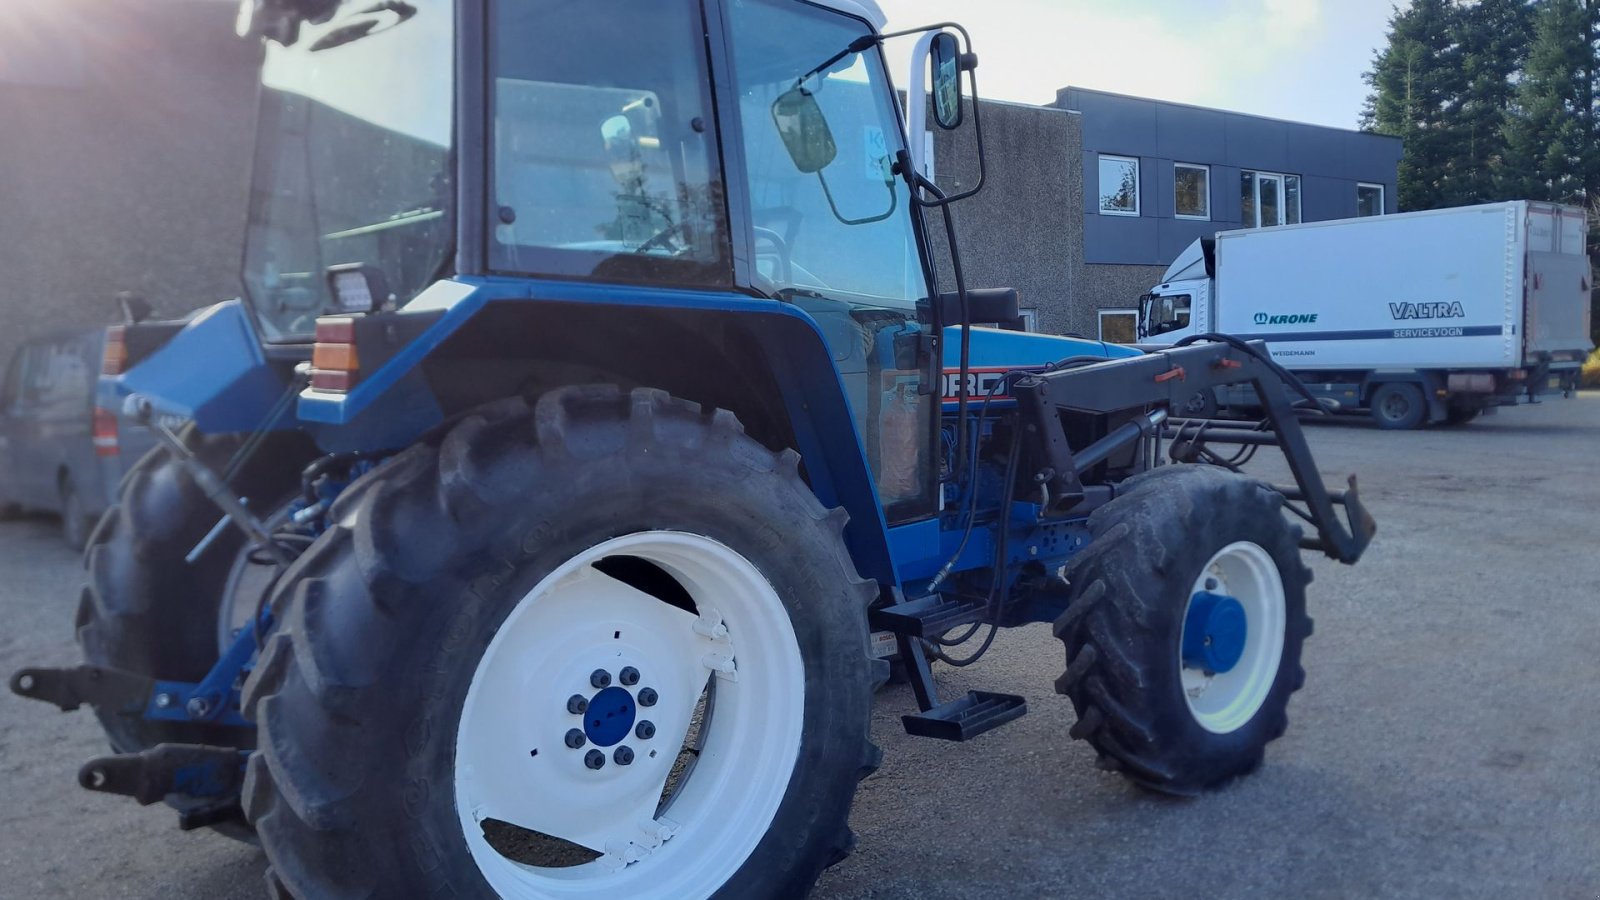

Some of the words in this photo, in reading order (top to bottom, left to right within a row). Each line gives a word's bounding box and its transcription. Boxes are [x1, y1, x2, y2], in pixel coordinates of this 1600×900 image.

[1389, 301, 1465, 320] VALTRA
[1268, 313, 1318, 325] KRONE
[1393, 327, 1463, 339] SERVICEVOGN
